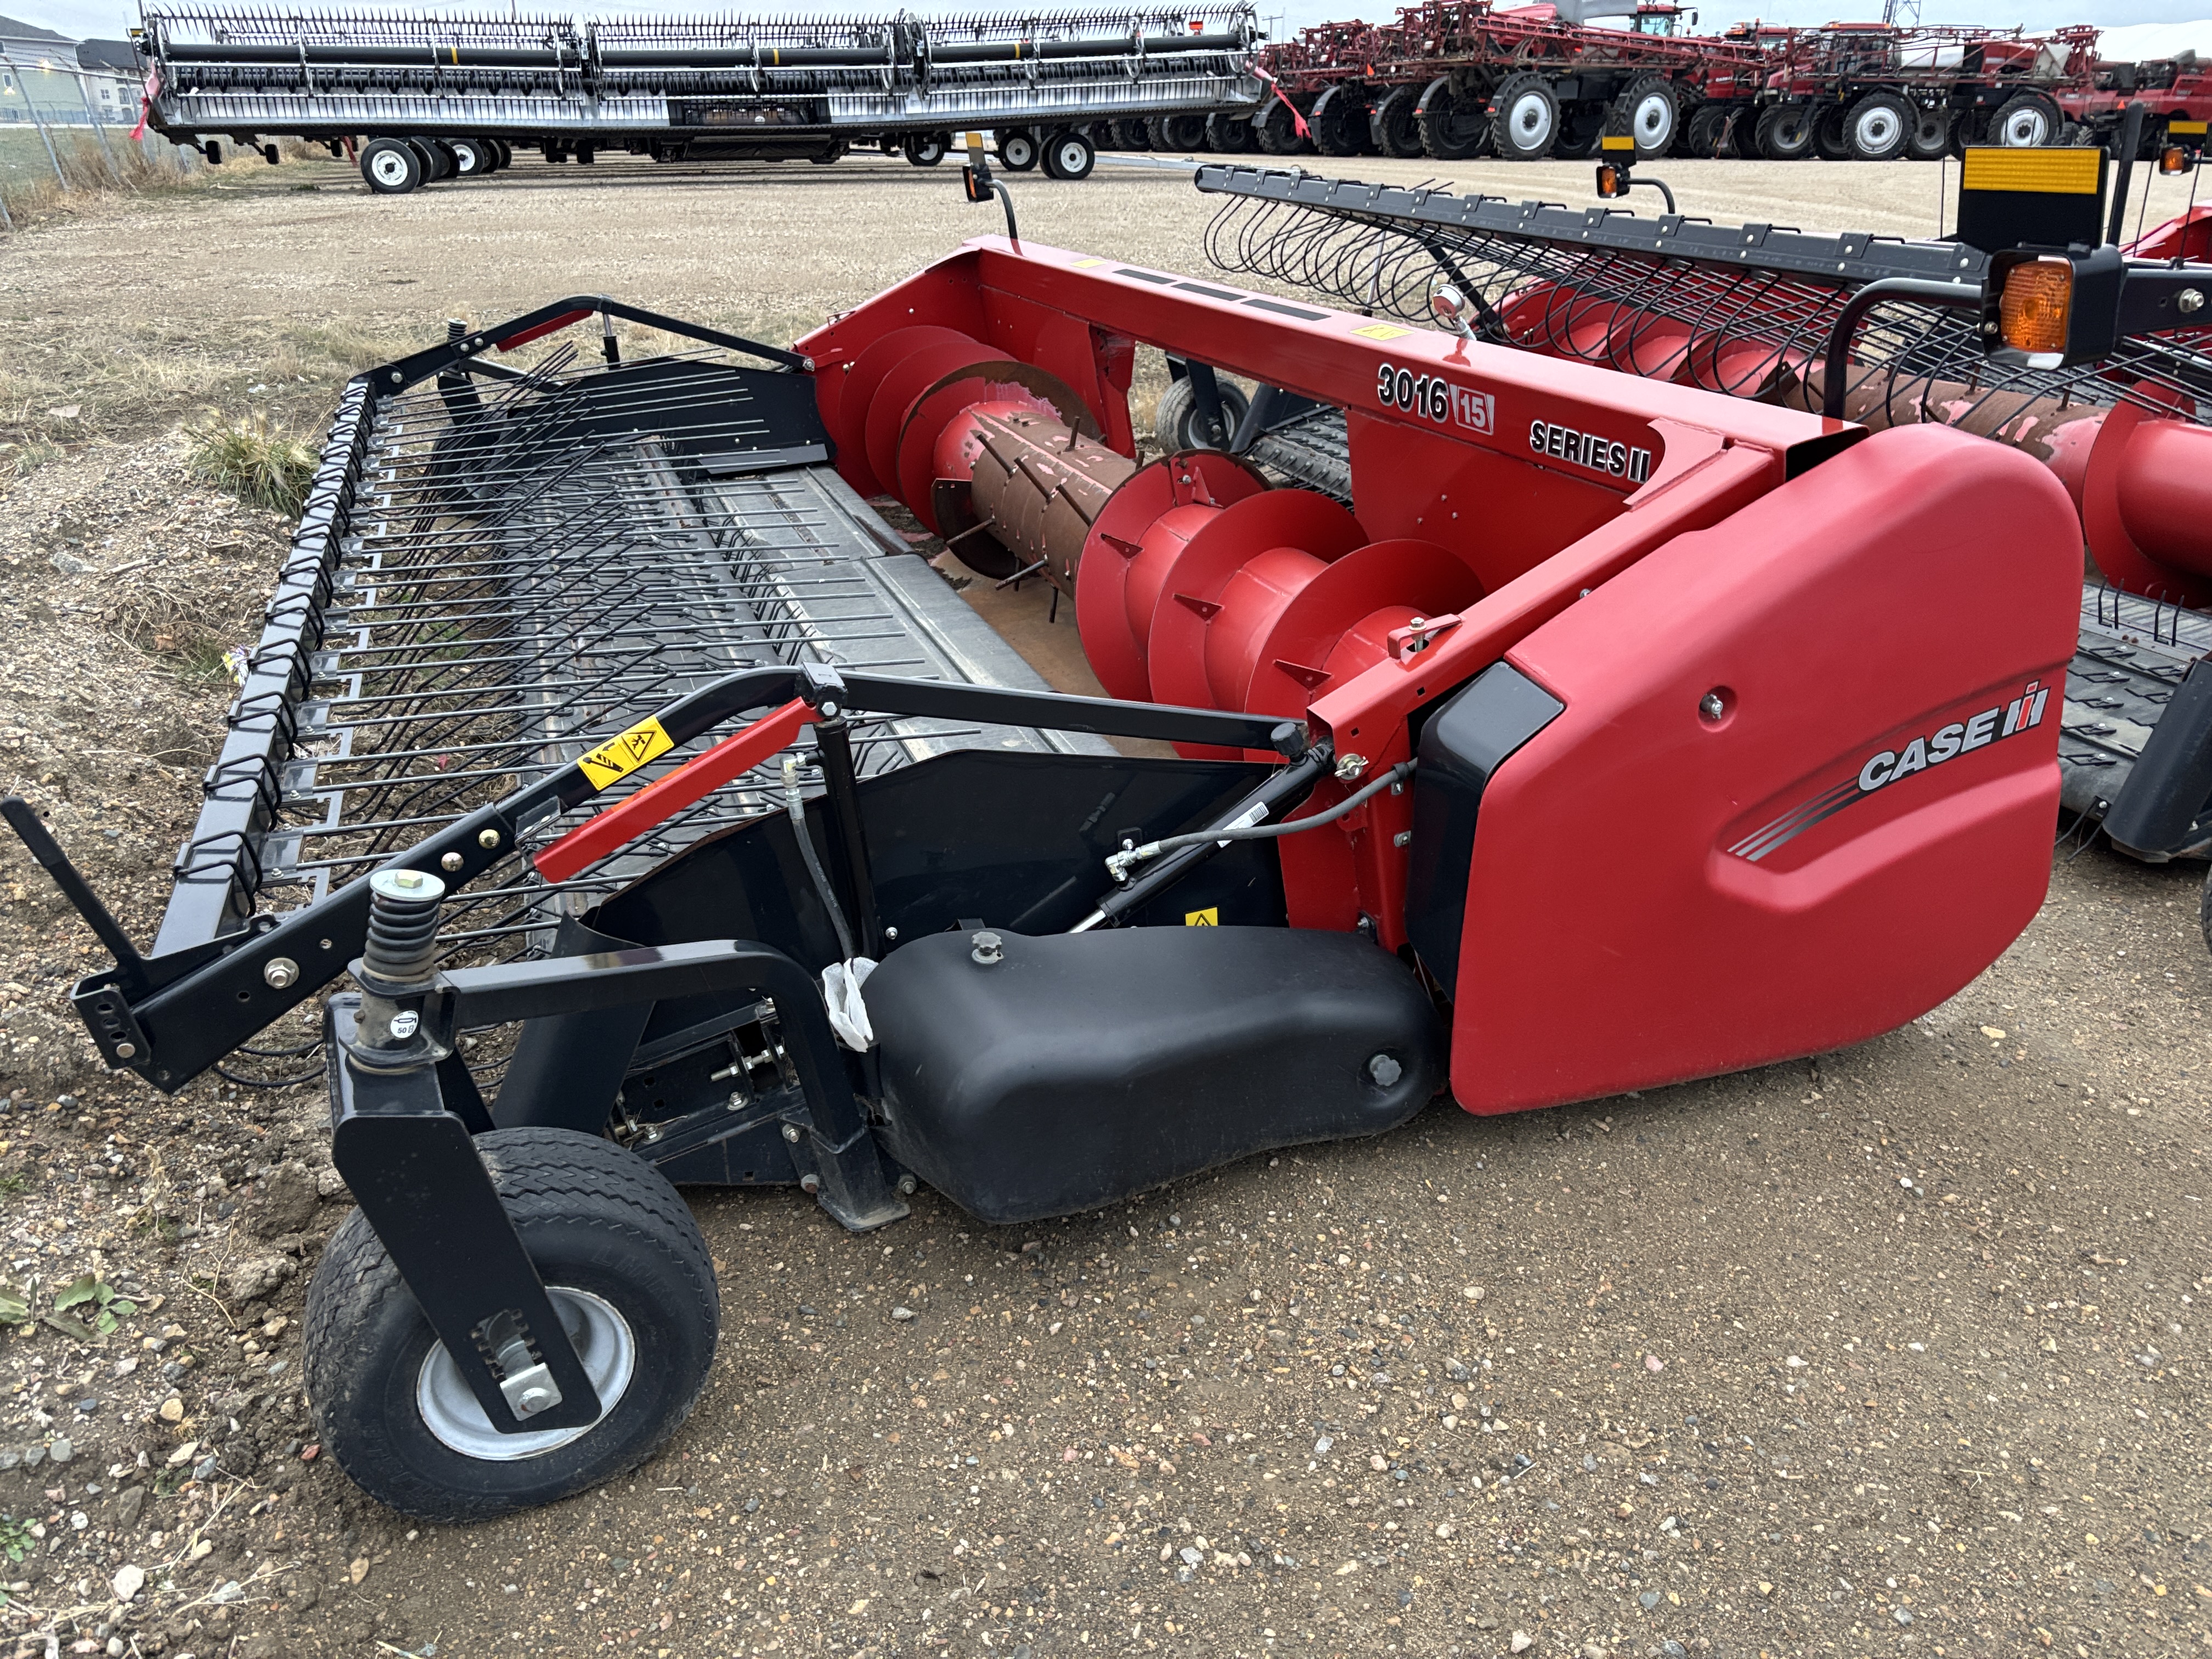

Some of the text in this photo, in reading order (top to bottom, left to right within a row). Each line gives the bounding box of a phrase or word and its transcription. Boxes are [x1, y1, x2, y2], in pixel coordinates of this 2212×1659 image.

[1378, 363, 1651, 483] 3016 15 SERIES II
[1858, 707, 2000, 791] CASE
